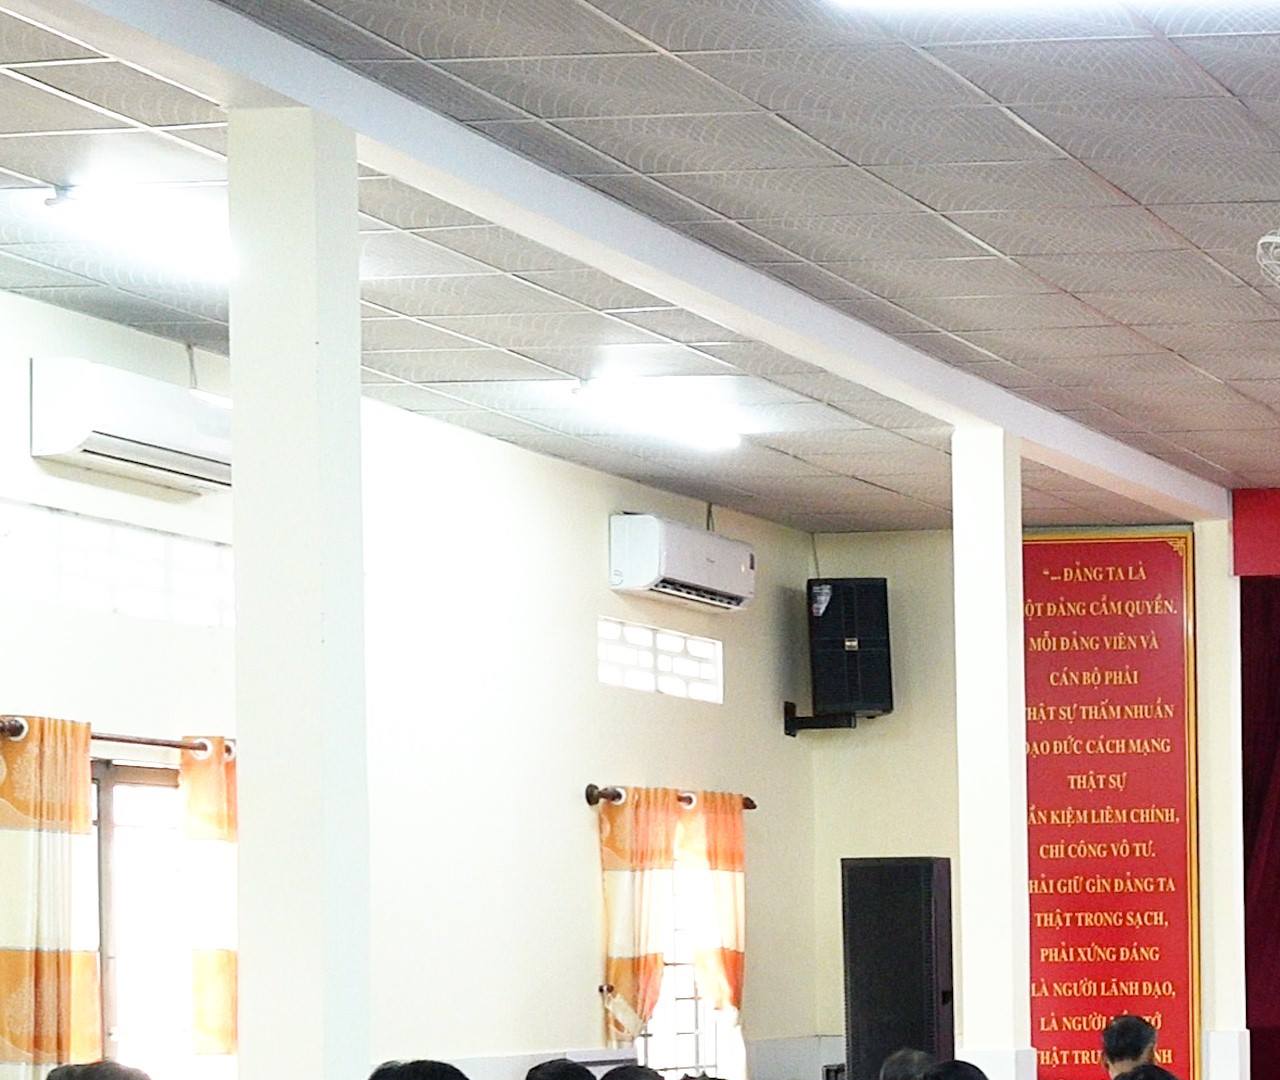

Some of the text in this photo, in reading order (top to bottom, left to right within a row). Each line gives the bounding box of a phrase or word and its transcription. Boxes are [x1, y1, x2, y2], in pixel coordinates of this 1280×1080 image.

[1105, 566, 1125, 581] TA
[1128, 561, 1146, 580] LÀ
[1025, 598, 1046, 621] ỘT
[1047, 596, 1086, 617] ĐẢNG
[1090, 594, 1122, 616] CẦM
[1029, 631, 1159, 652] MỖI ĐẢNG VIÊN VÀ
[1050, 665, 1138, 690] CÁN BỘ PHẢI
[1059, 703, 1078, 724] SỰ
[1124, 697, 1175, 719] NHUẦN
[1053, 735, 1083, 755] ĐỨC
[1086, 735, 1126, 754] CÁCH
[1126, 738, 1171, 756] MẠNG
[1067, 770, 1128, 792] THẬT SỰ
[1028, 804, 1047, 825] ẦN
[1050, 806, 1088, 827] KIỆM
[1091, 805, 1127, 823] LIÊM
[1068, 839, 1107, 858] CÔNG
[1110, 838, 1129, 858] VÔ
[1133, 840, 1156, 858] TƯ.
[1029, 872, 1176, 894] HẢI GIỮ GÌN ĐẢNG TA
[1034, 909, 1169, 930] THẬT TRONG SẠCH,
[1040, 941, 1160, 962] PHẢI XỨNG ĐÁNG
[1031, 978, 1176, 999] LÀ NGƯỜI LÃNH ĐẠO,
[1040, 1012, 1058, 1031] LÀ
[1062, 1011, 1106, 1031] NGƯỜI
[1037, 1046, 1101, 1067] HẬT TRU
